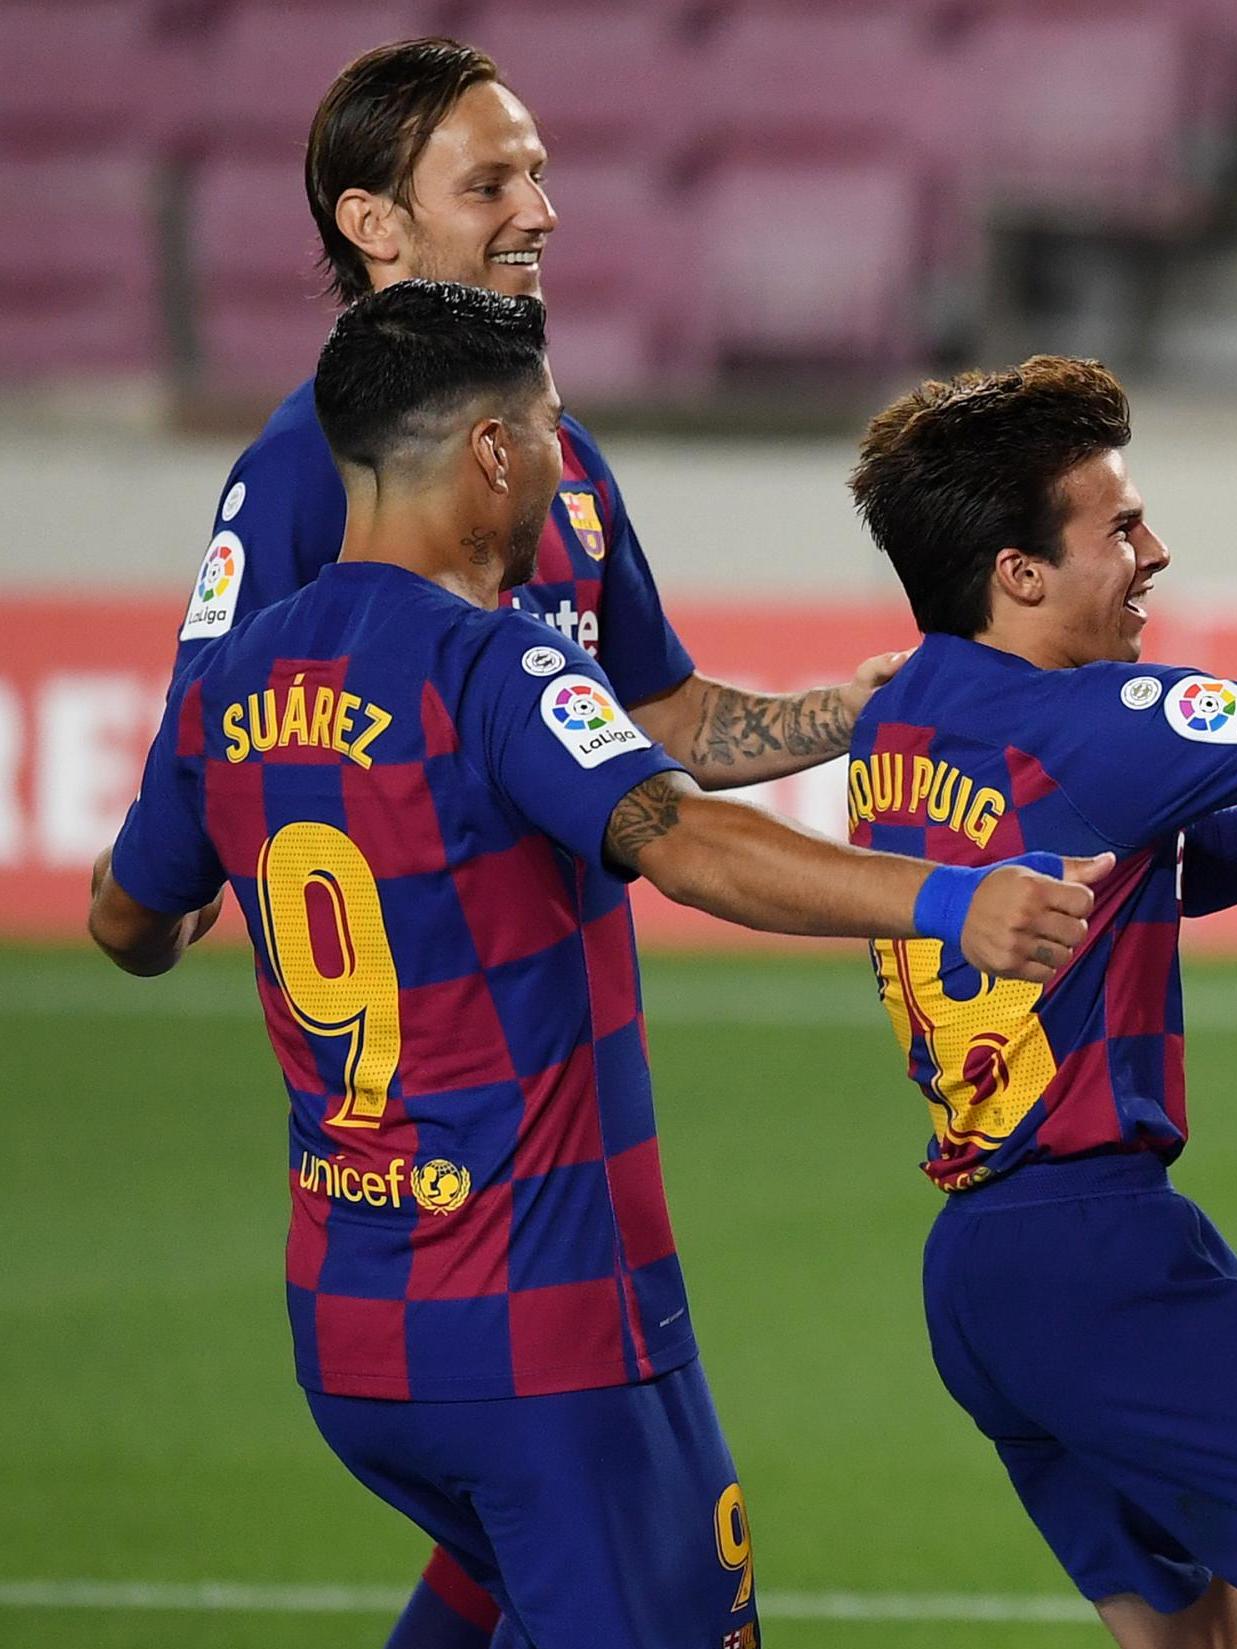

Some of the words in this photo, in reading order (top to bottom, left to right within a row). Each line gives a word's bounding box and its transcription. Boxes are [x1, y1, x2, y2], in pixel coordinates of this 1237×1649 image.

[188, 606, 227, 625] LaLiga
[222, 673, 393, 770] SUÁREZ
[579, 729, 636, 755] LaLiga
[908, 755, 1006, 850] PUIG
[256, 820, 401, 1130] 9
[300, 1150, 405, 1209] unicef
[713, 1482, 753, 1613] 9
